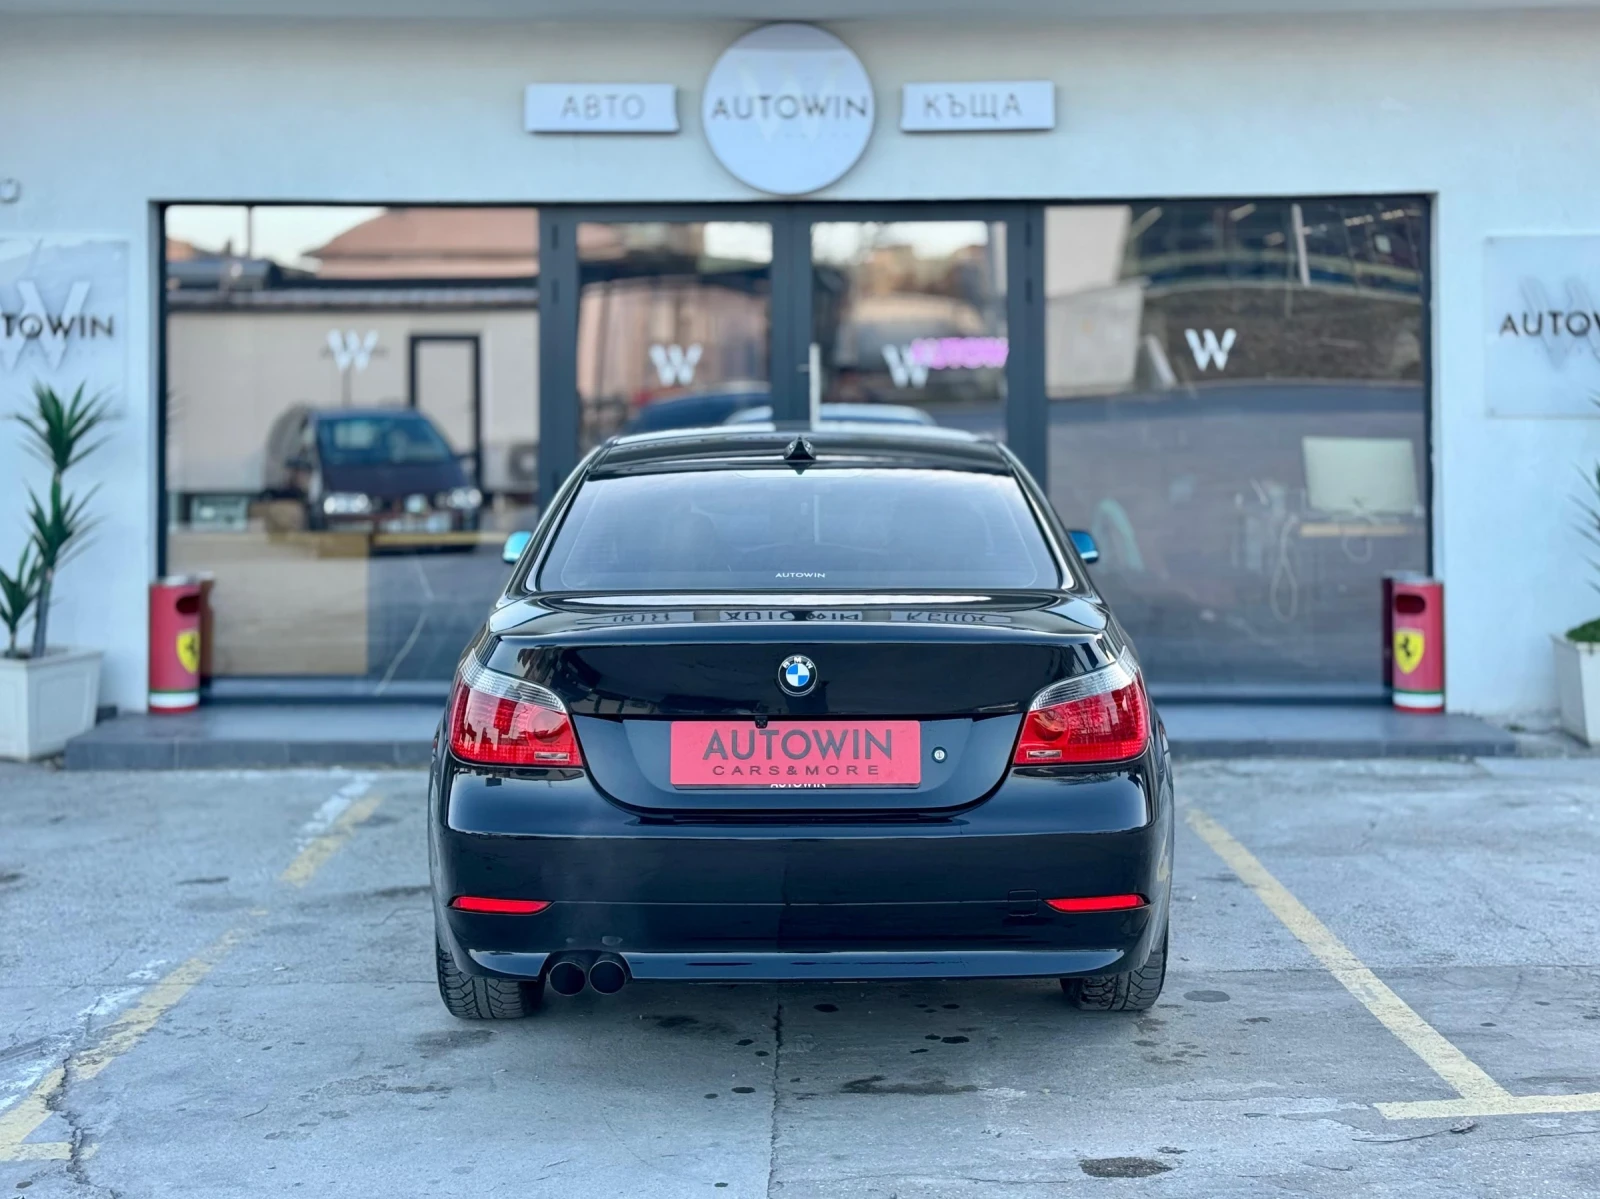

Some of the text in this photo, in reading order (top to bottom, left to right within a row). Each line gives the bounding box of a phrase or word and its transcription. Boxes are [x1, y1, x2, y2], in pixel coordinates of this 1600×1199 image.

[561, 93, 646, 120] АВТО
[711, 94, 868, 121] AUTOWIN
[923, 91, 1023, 121] КЪЩА
[326, 328, 379, 374] W
[648, 343, 703, 386] W
[1184, 328, 1237, 372] W
[782, 656, 813, 669] BMW
[703, 728, 892, 760] AUTOWIN
[712, 764, 880, 776] CARS&MORE
